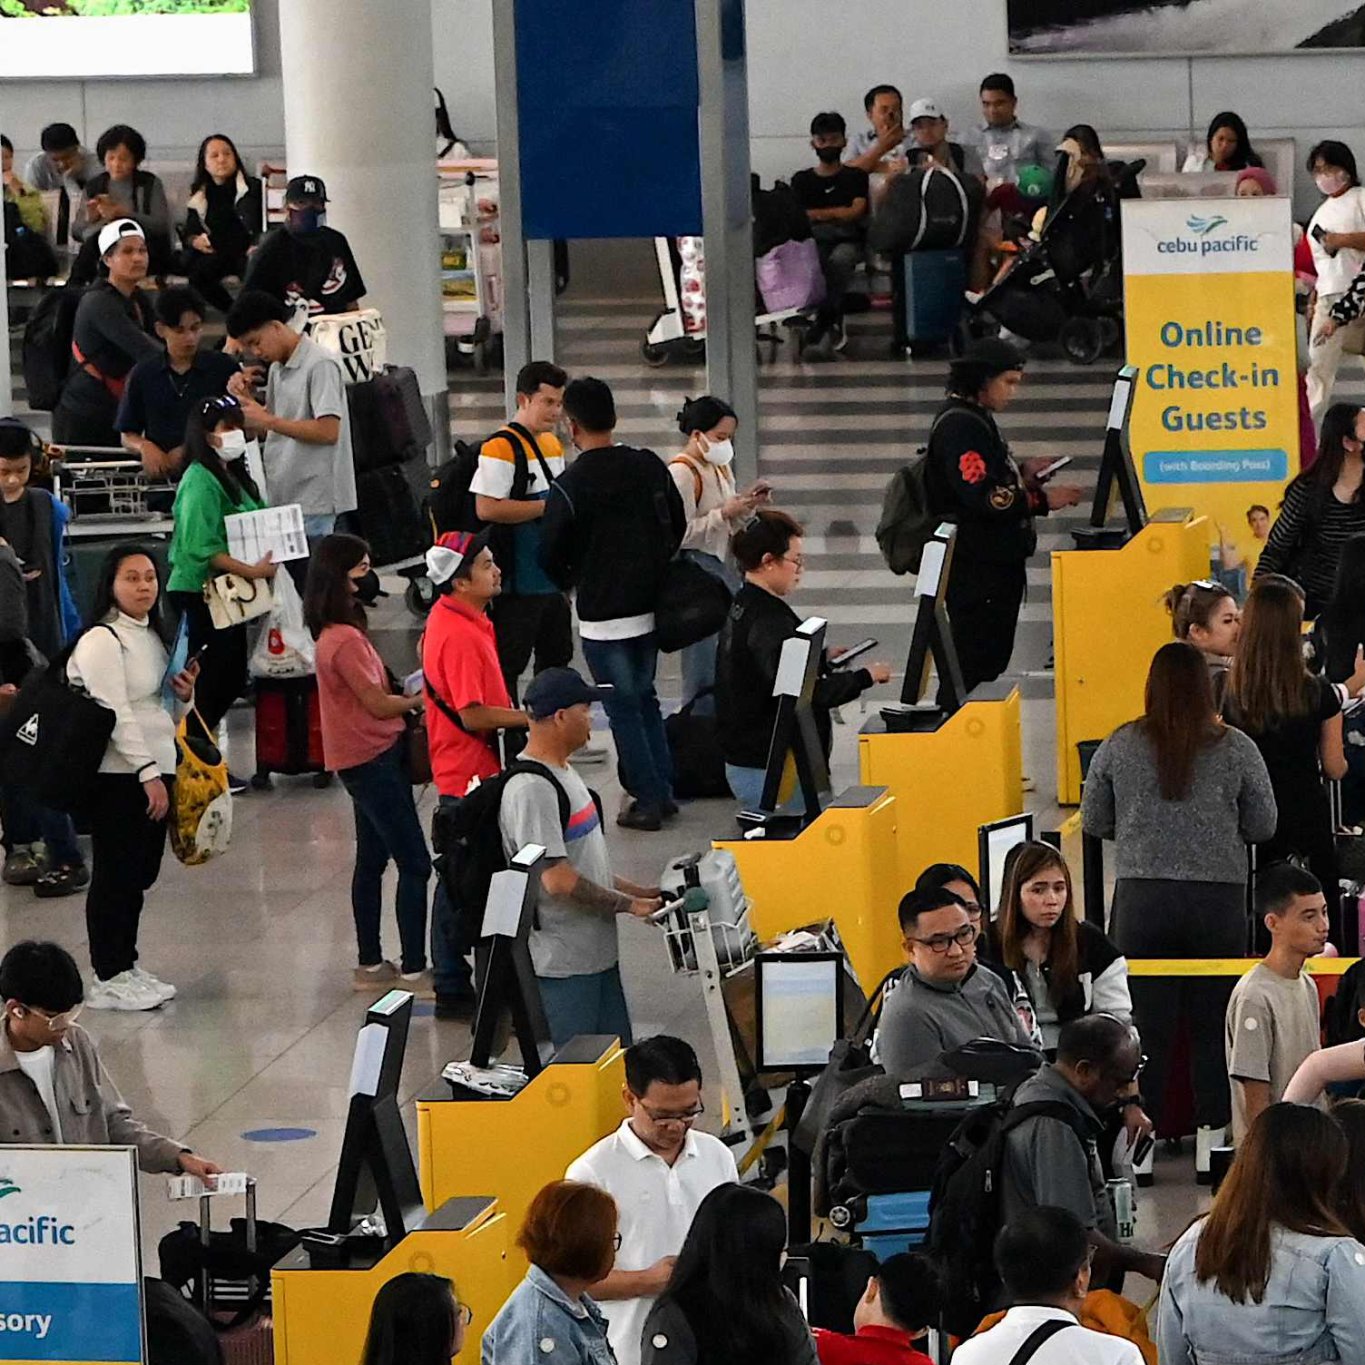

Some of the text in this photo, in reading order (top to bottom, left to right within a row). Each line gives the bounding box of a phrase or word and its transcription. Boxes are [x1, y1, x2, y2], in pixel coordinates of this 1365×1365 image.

[1157, 235, 1258, 257] cebu pacific
[1160, 320, 1262, 348] Online
[1146, 362, 1279, 391] Check-in
[1161, 404, 1266, 432] Guests
[1190, 459, 1240, 474] Boarding
[1242, 459, 1270, 472] Pass)
